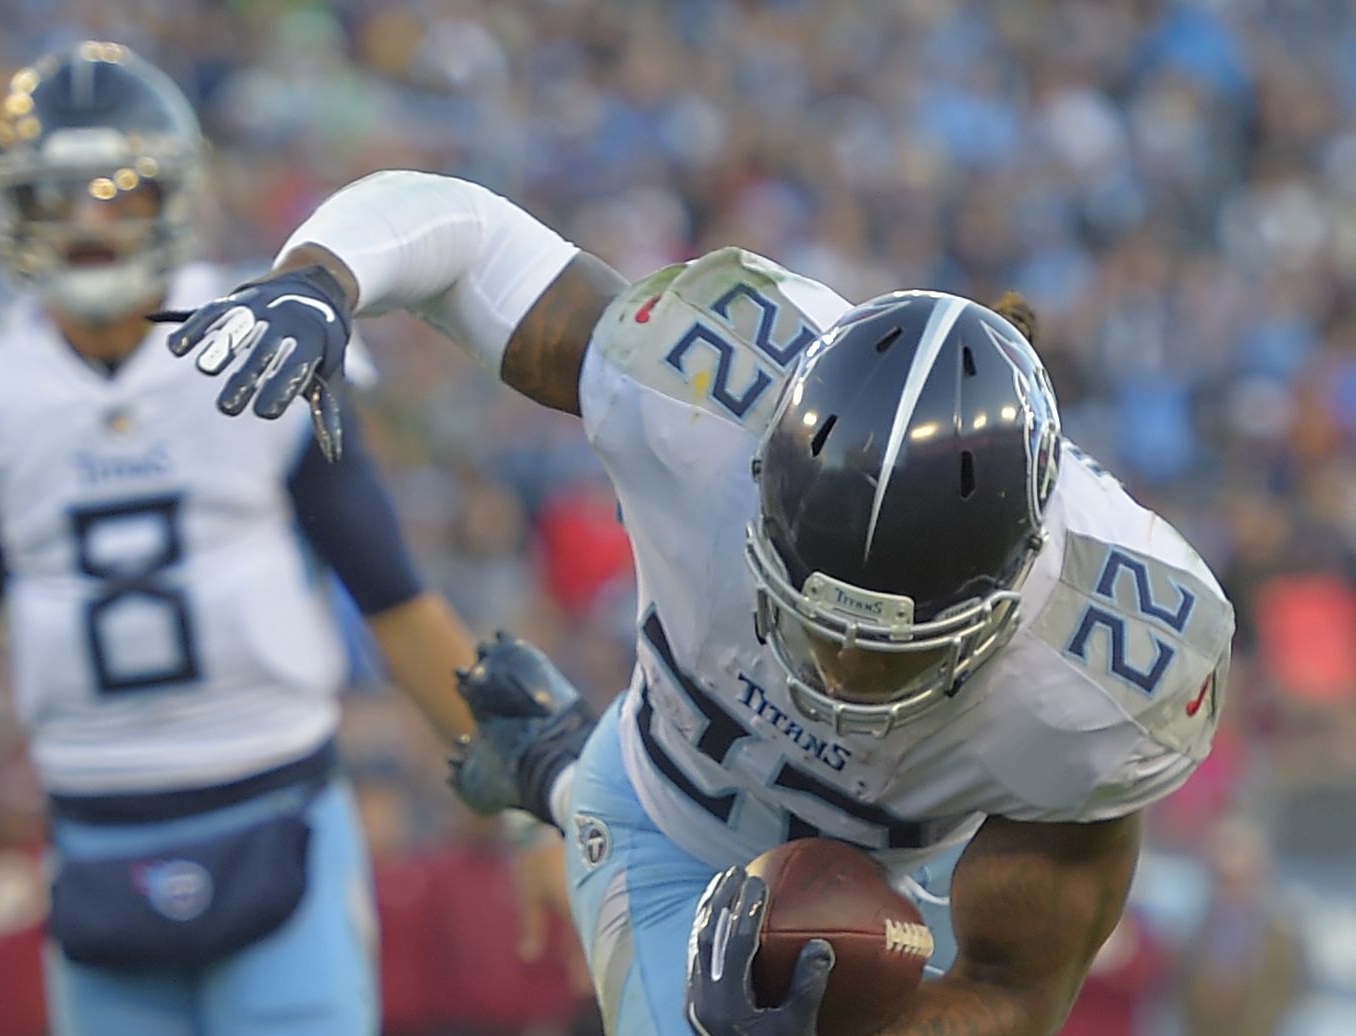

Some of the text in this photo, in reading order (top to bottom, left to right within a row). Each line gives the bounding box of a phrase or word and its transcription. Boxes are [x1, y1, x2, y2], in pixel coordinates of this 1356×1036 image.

[662, 281, 820, 419] 22
[68, 494, 204, 695] 8
[836, 587, 884, 615] TITANS
[1063, 545, 1197, 697] 22
[738, 673, 851, 771] TITANS
